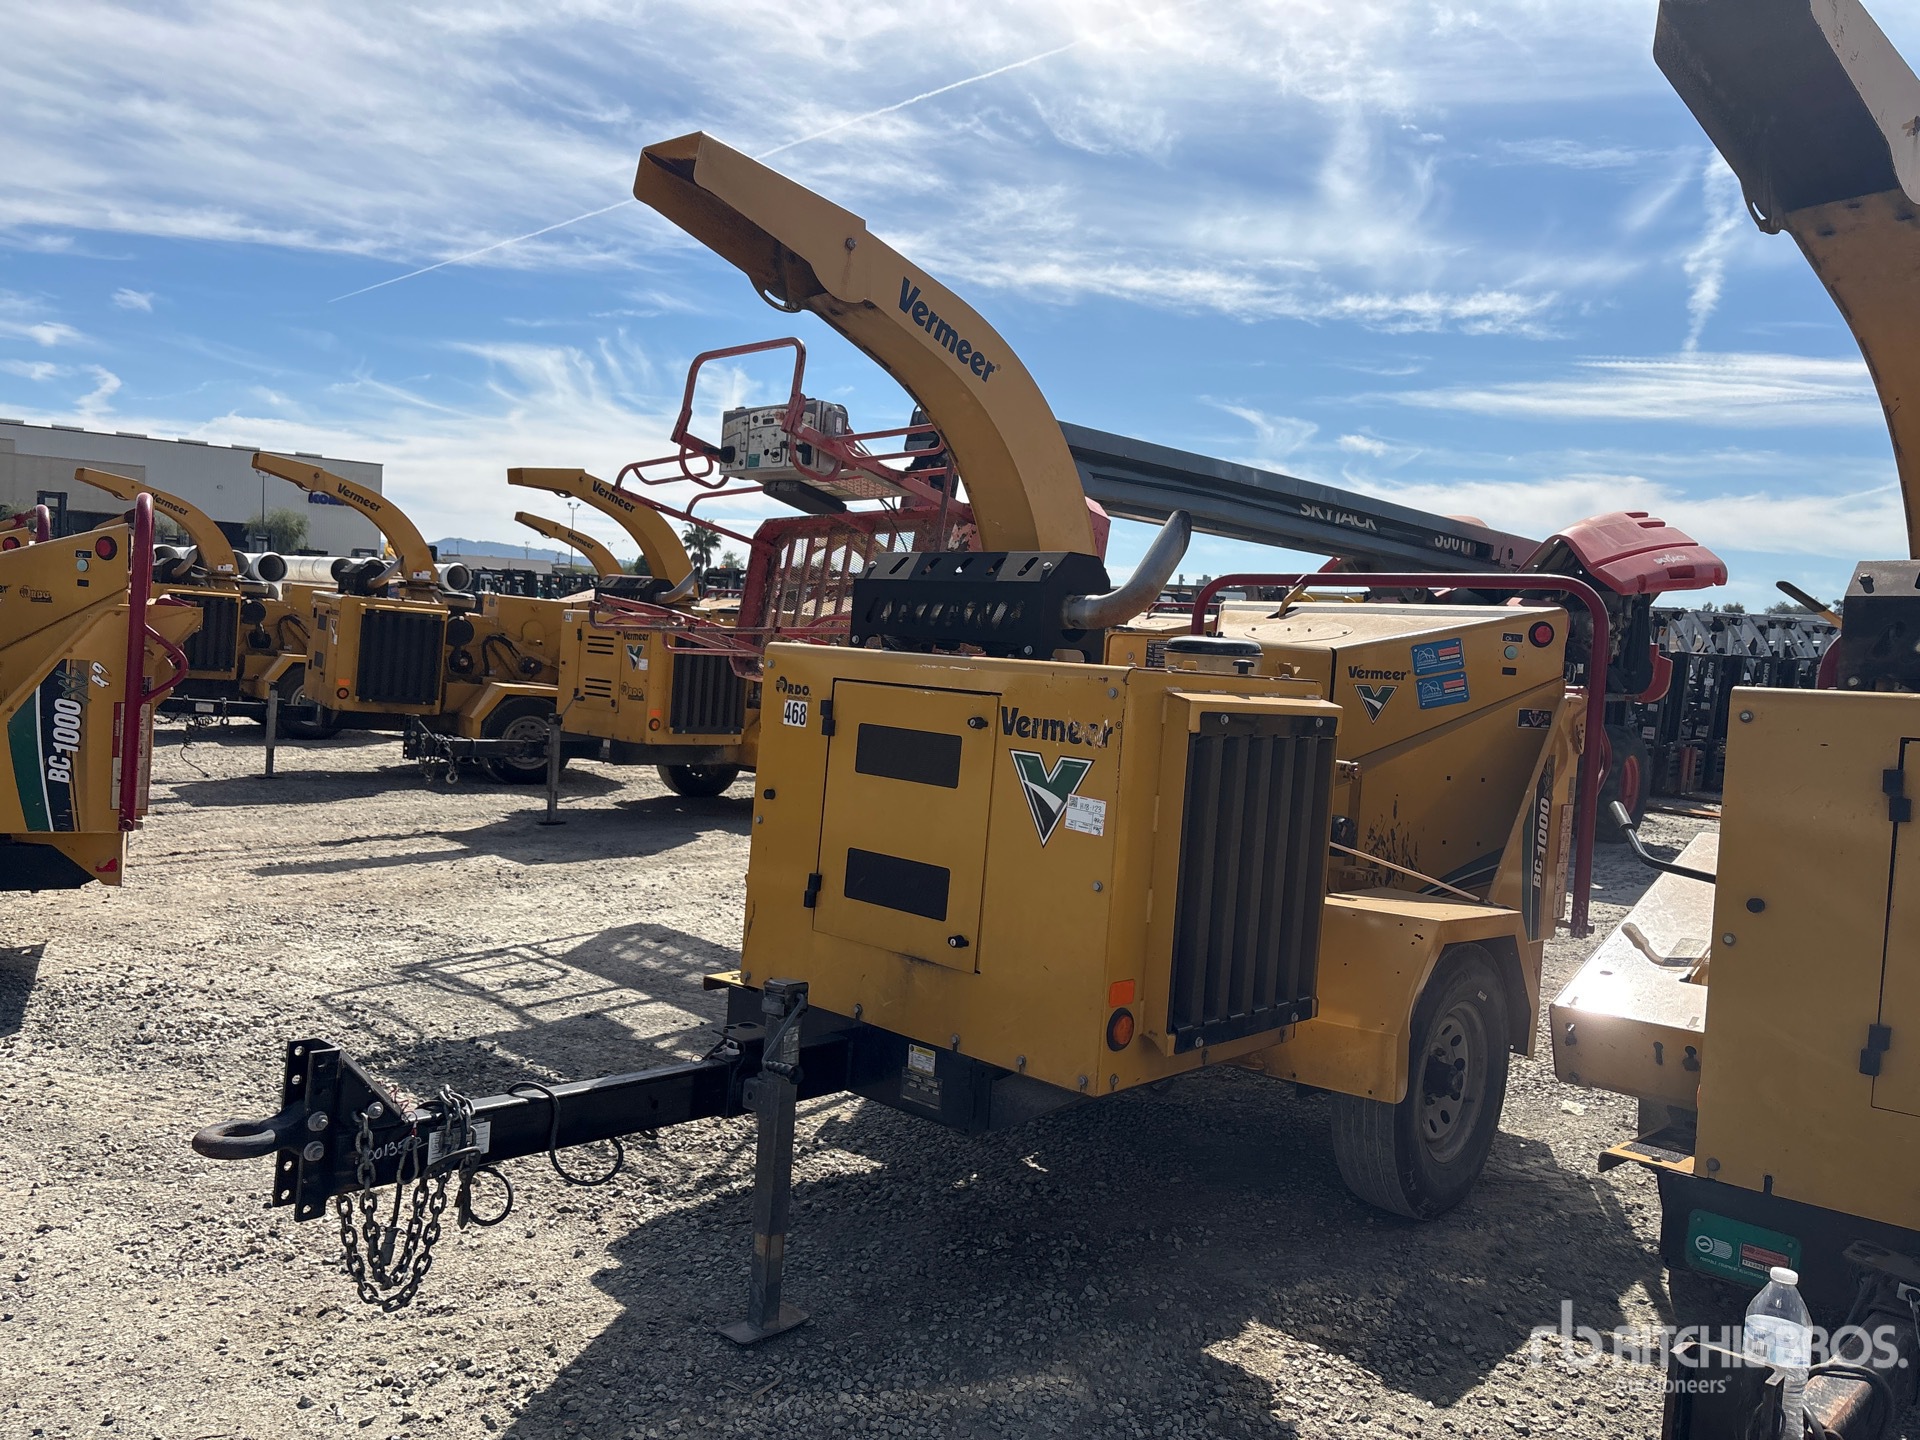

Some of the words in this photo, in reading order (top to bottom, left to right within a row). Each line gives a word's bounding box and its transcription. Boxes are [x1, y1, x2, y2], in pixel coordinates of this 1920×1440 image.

[899, 276, 996, 383] Vermeer
[337, 482, 382, 512] Vermeer
[592, 480, 636, 513] Vermeer
[567, 530, 594, 550] Vermeer
[623, 631, 650, 642] Vermeer
[1348, 665, 1407, 681] Vermeer
[784, 701, 807, 726] 468
